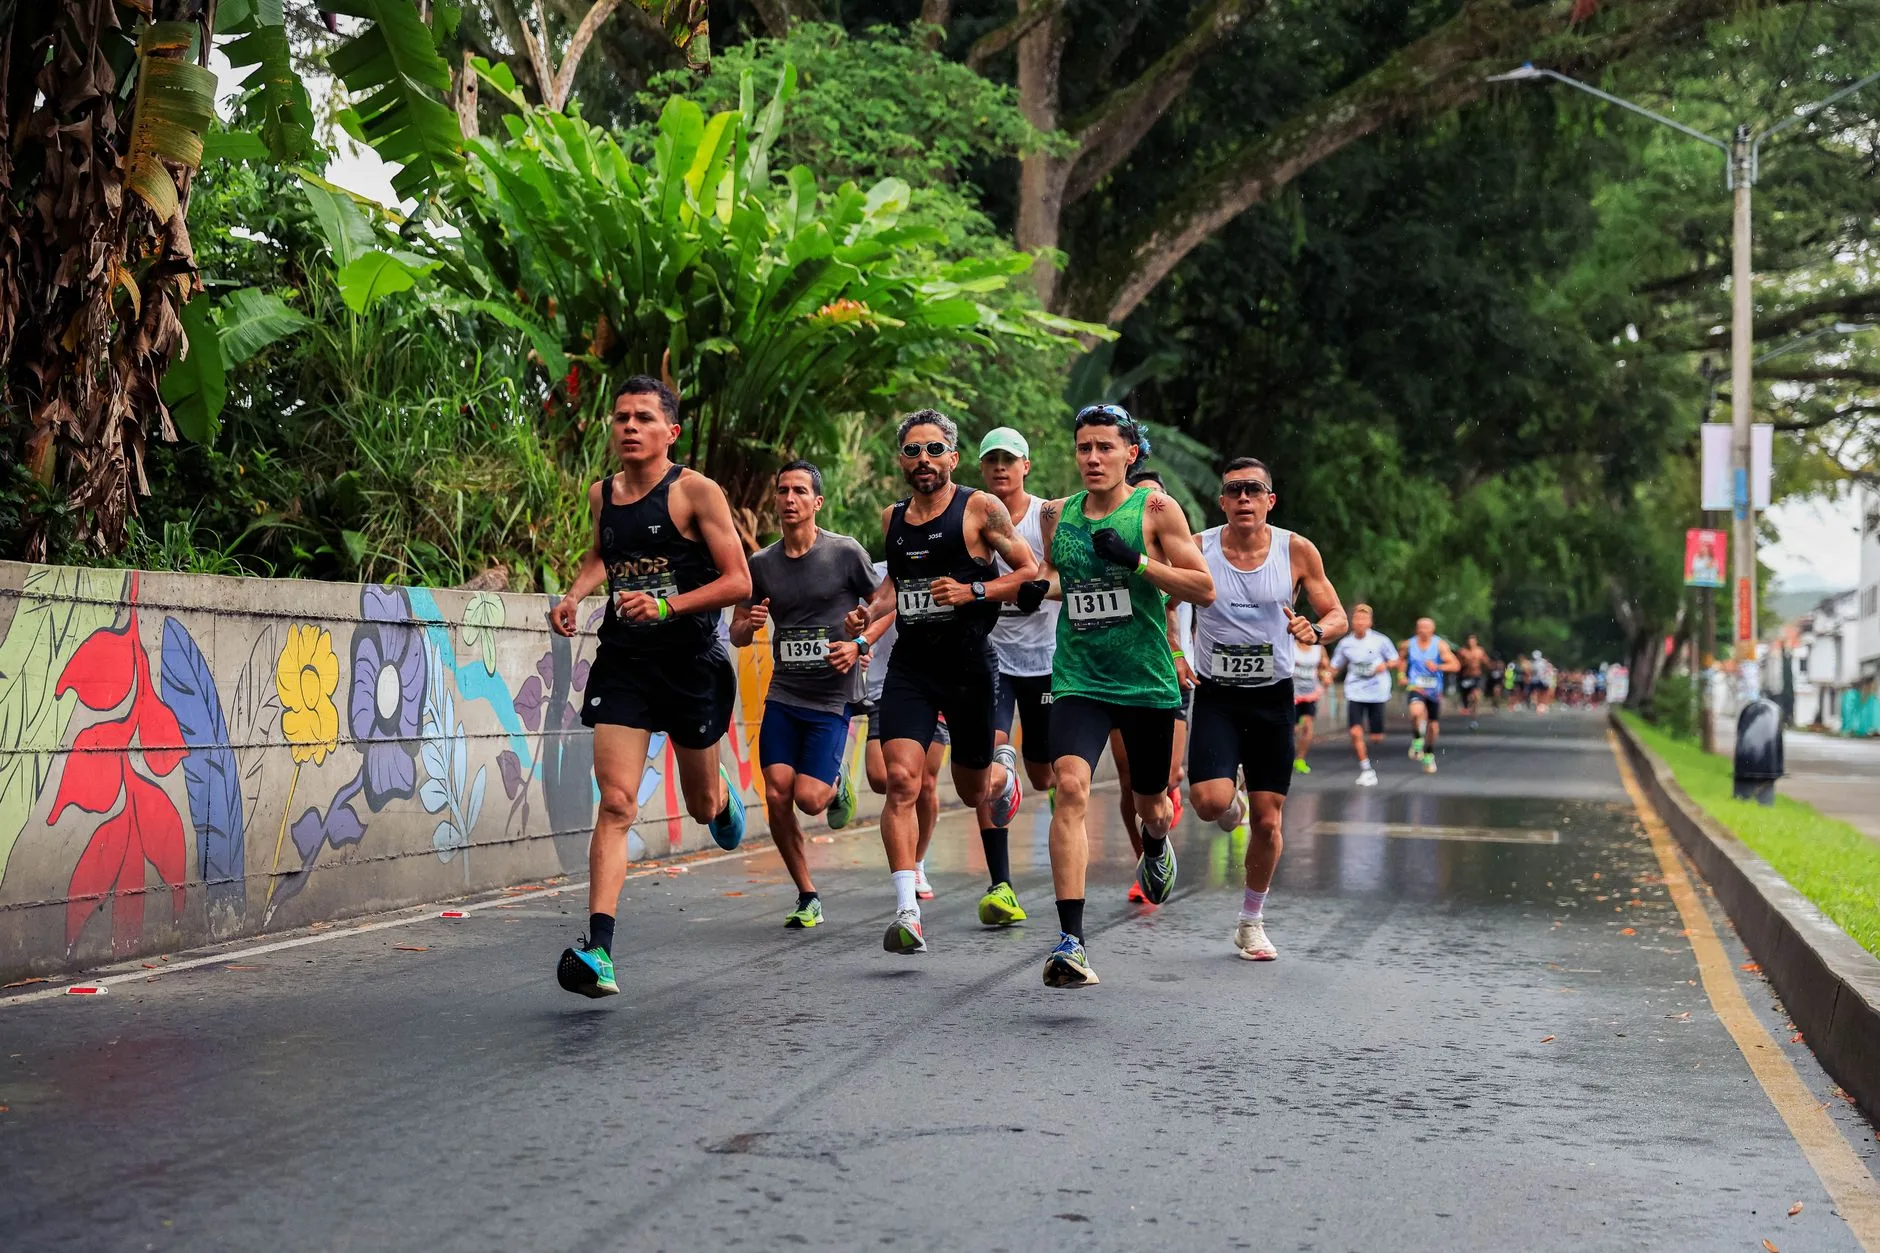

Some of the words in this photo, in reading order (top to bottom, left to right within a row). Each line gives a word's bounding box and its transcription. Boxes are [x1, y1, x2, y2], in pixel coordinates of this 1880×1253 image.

[928, 532, 943, 541] JOSE
[1074, 593, 1118, 614] 1311
[787, 642, 822, 657] 1396
[1222, 656, 1265, 673] 1252
